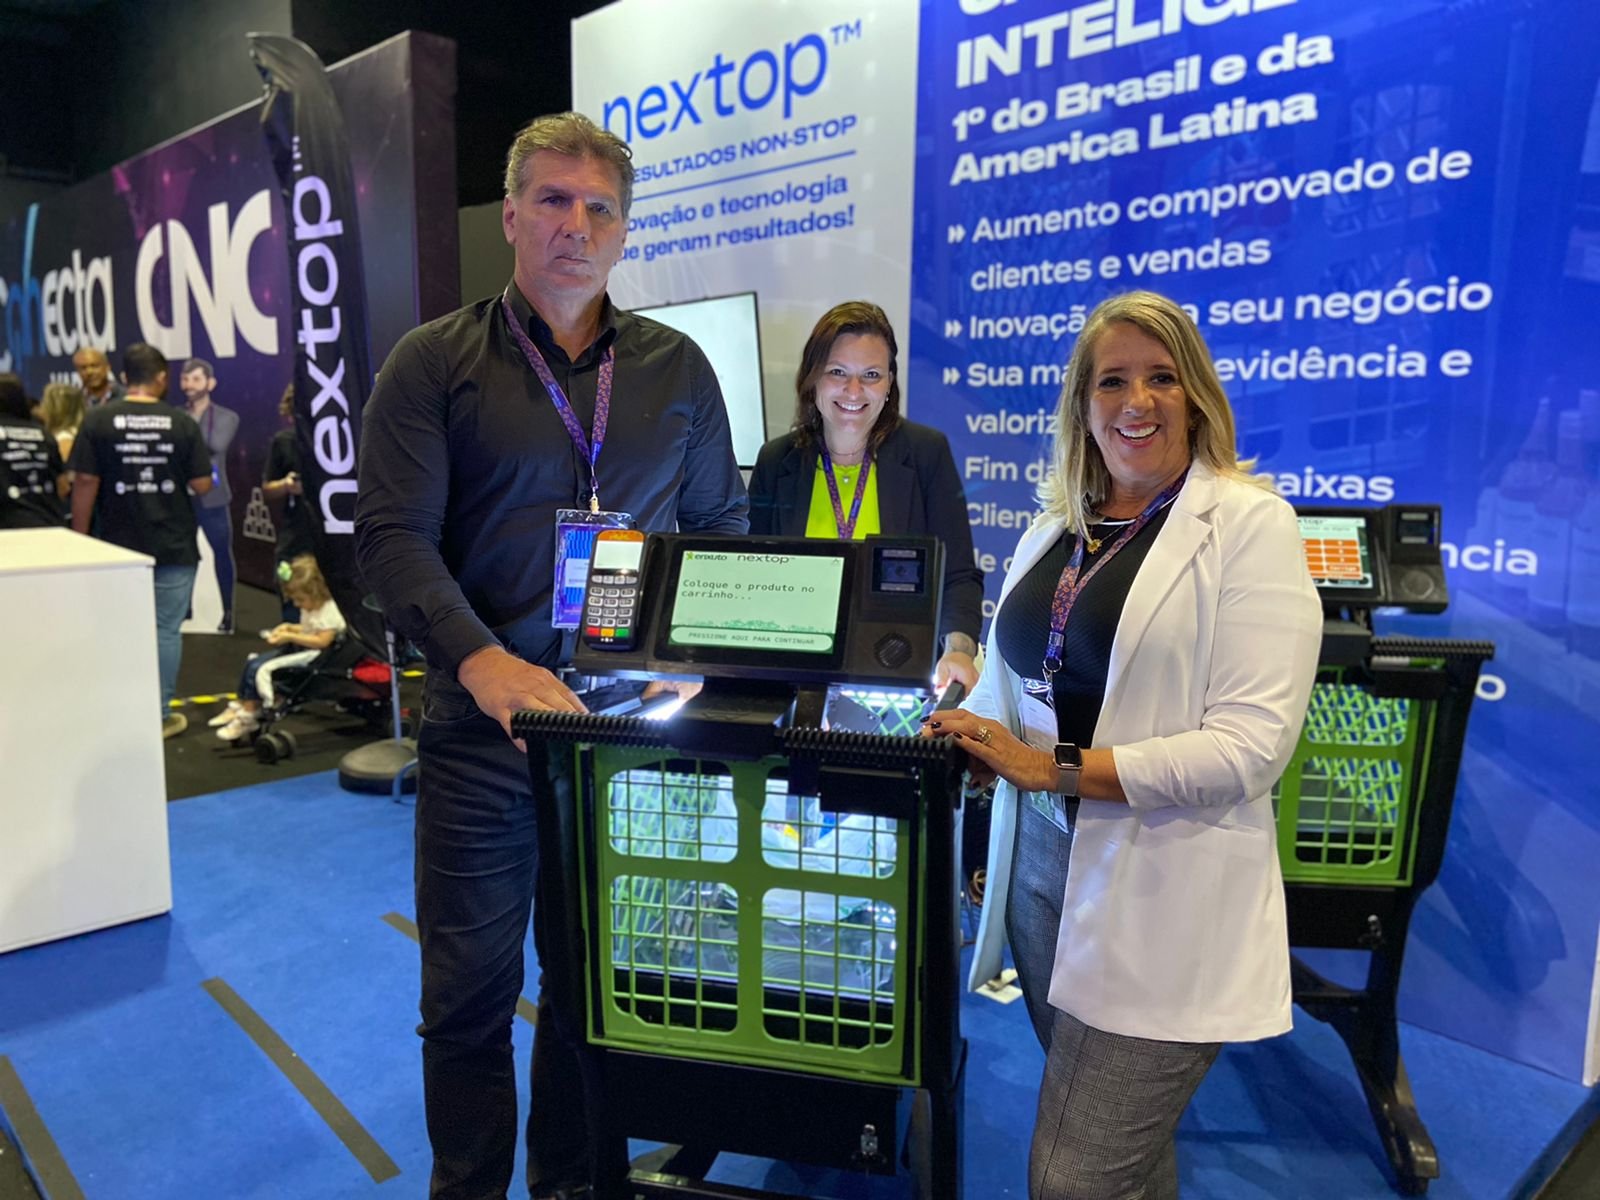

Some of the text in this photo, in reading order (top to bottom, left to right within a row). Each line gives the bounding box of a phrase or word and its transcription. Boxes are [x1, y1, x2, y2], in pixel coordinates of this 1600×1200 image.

[991, 98, 1048, 134] do
[1055, 54, 1202, 121] Brasil
[1209, 53, 1248, 86] e
[1256, 32, 1335, 76] da
[632, 115, 858, 184] ESULTADOS NON-STOP
[950, 92, 1318, 187] America Latina
[627, 174, 849, 233] ovação e tecnologia
[972, 147, 1473, 245] Aumento comprovado de
[643, 233, 711, 262] geram
[715, 204, 856, 247] resultados!
[135, 188, 280, 360] CNC
[970, 234, 1272, 293] clientes e vendas
[968, 303, 1087, 341] Inovaçã
[1207, 294, 1284, 327] seu
[1296, 276, 1494, 324] negócio
[966, 362, 1024, 387] Sua
[1213, 344, 1428, 382] evidência
[1439, 348, 1473, 377] e
[964, 456, 1018, 482] Fim
[681, 590, 753, 600] carrinho...
[682, 579, 729, 590] Coloque
[748, 583, 795, 593] produto
[688, 631, 816, 646] PRESSIONE AQUI PARA CONTINUAR
